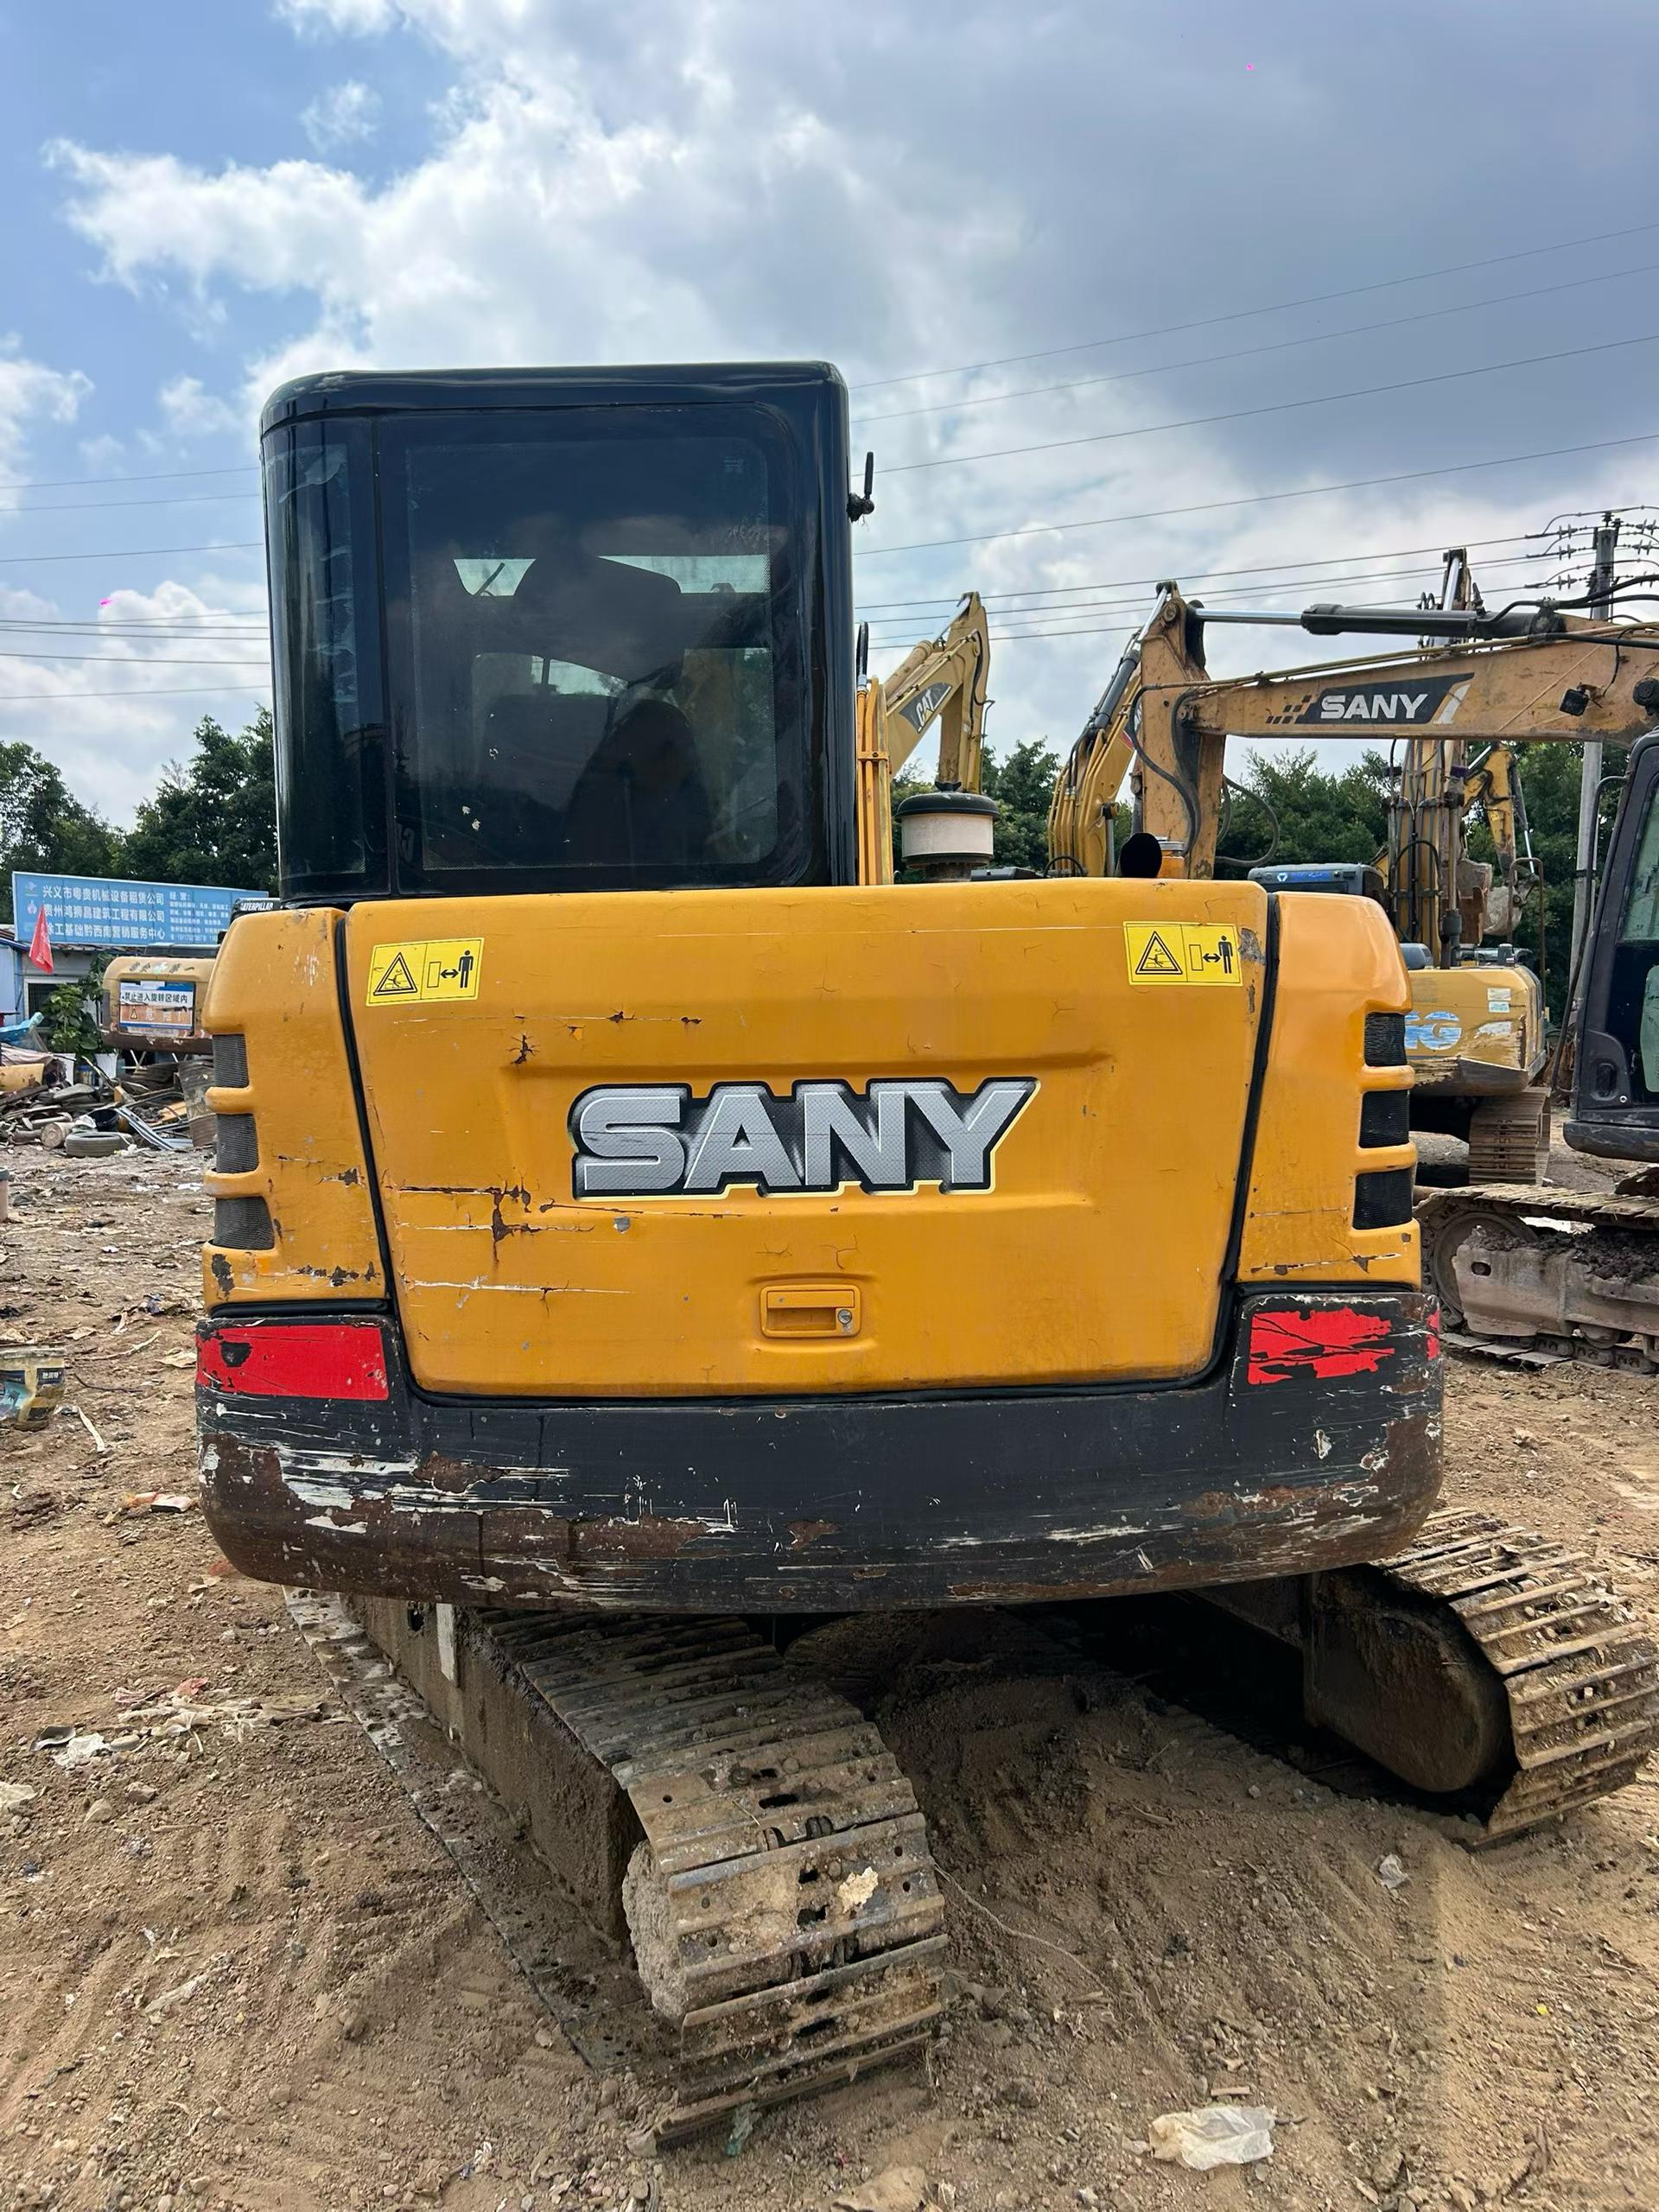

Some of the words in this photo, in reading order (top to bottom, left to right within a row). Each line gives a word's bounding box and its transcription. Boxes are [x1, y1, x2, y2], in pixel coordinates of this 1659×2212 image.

[916, 690, 935, 727] CAT
[1320, 694, 1428, 719] SANY
[124, 992, 188, 1003] 禁止进入旋转区域内
[572, 1084, 1034, 1194] SANY
